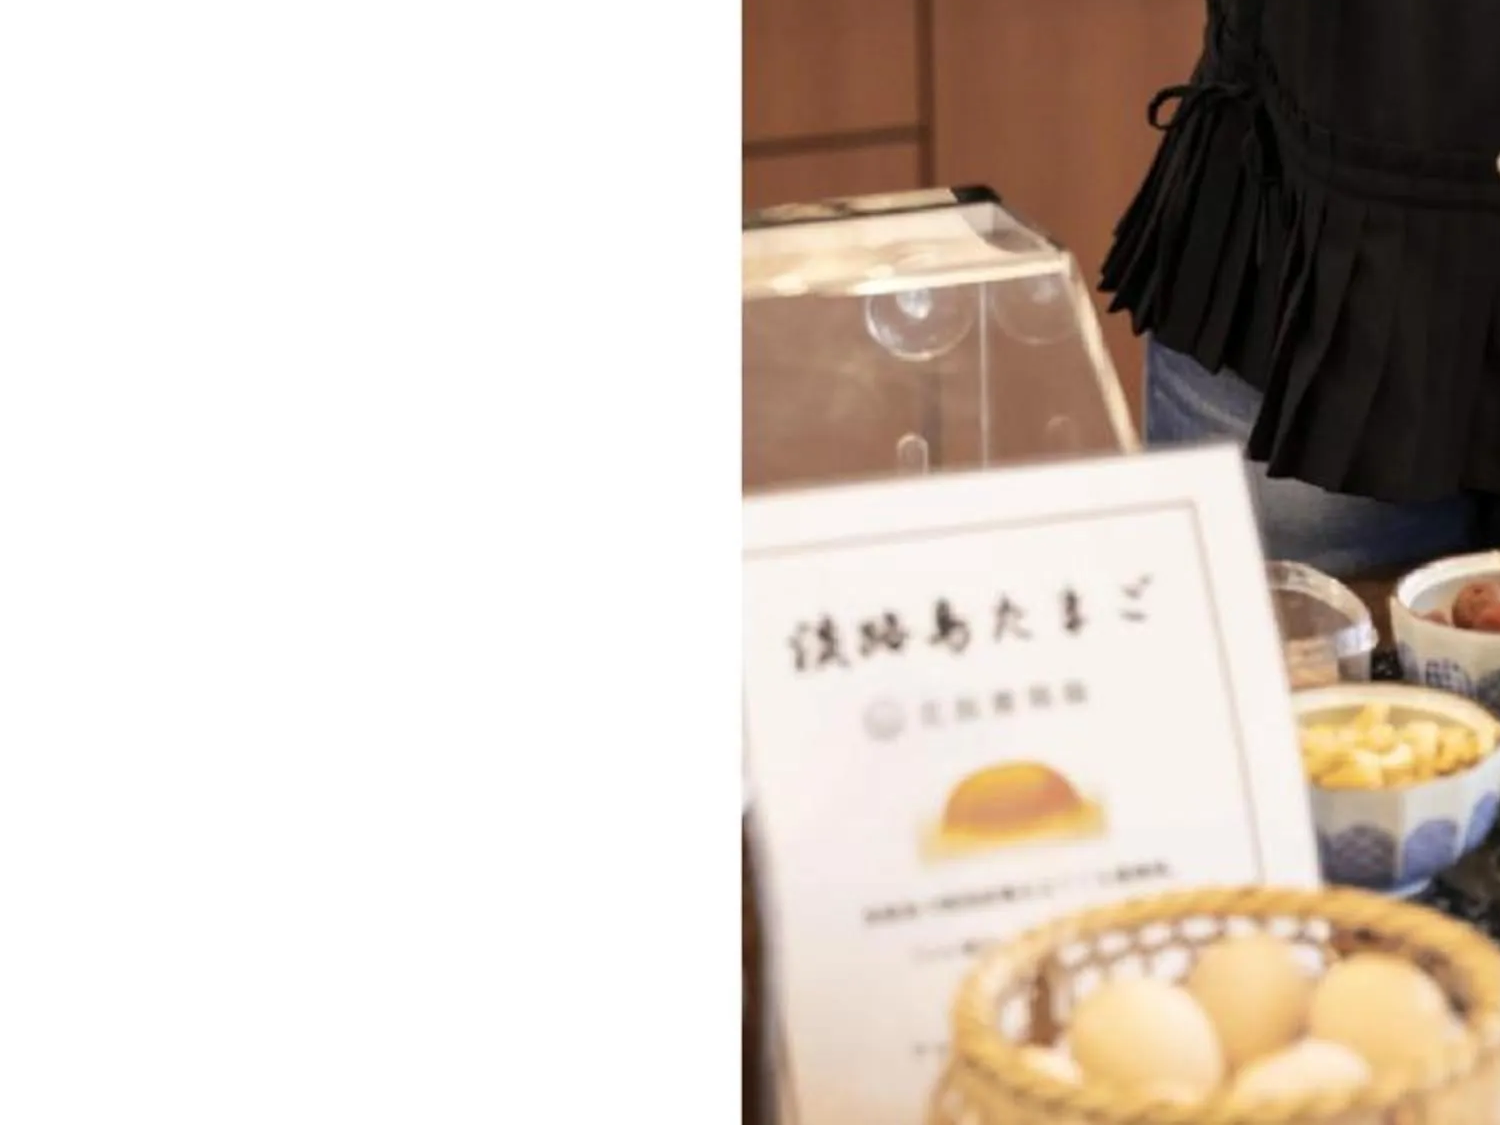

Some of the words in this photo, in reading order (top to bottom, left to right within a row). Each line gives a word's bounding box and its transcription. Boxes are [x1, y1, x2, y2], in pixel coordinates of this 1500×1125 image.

[788, 574, 1153, 672] 淡路島たまご
